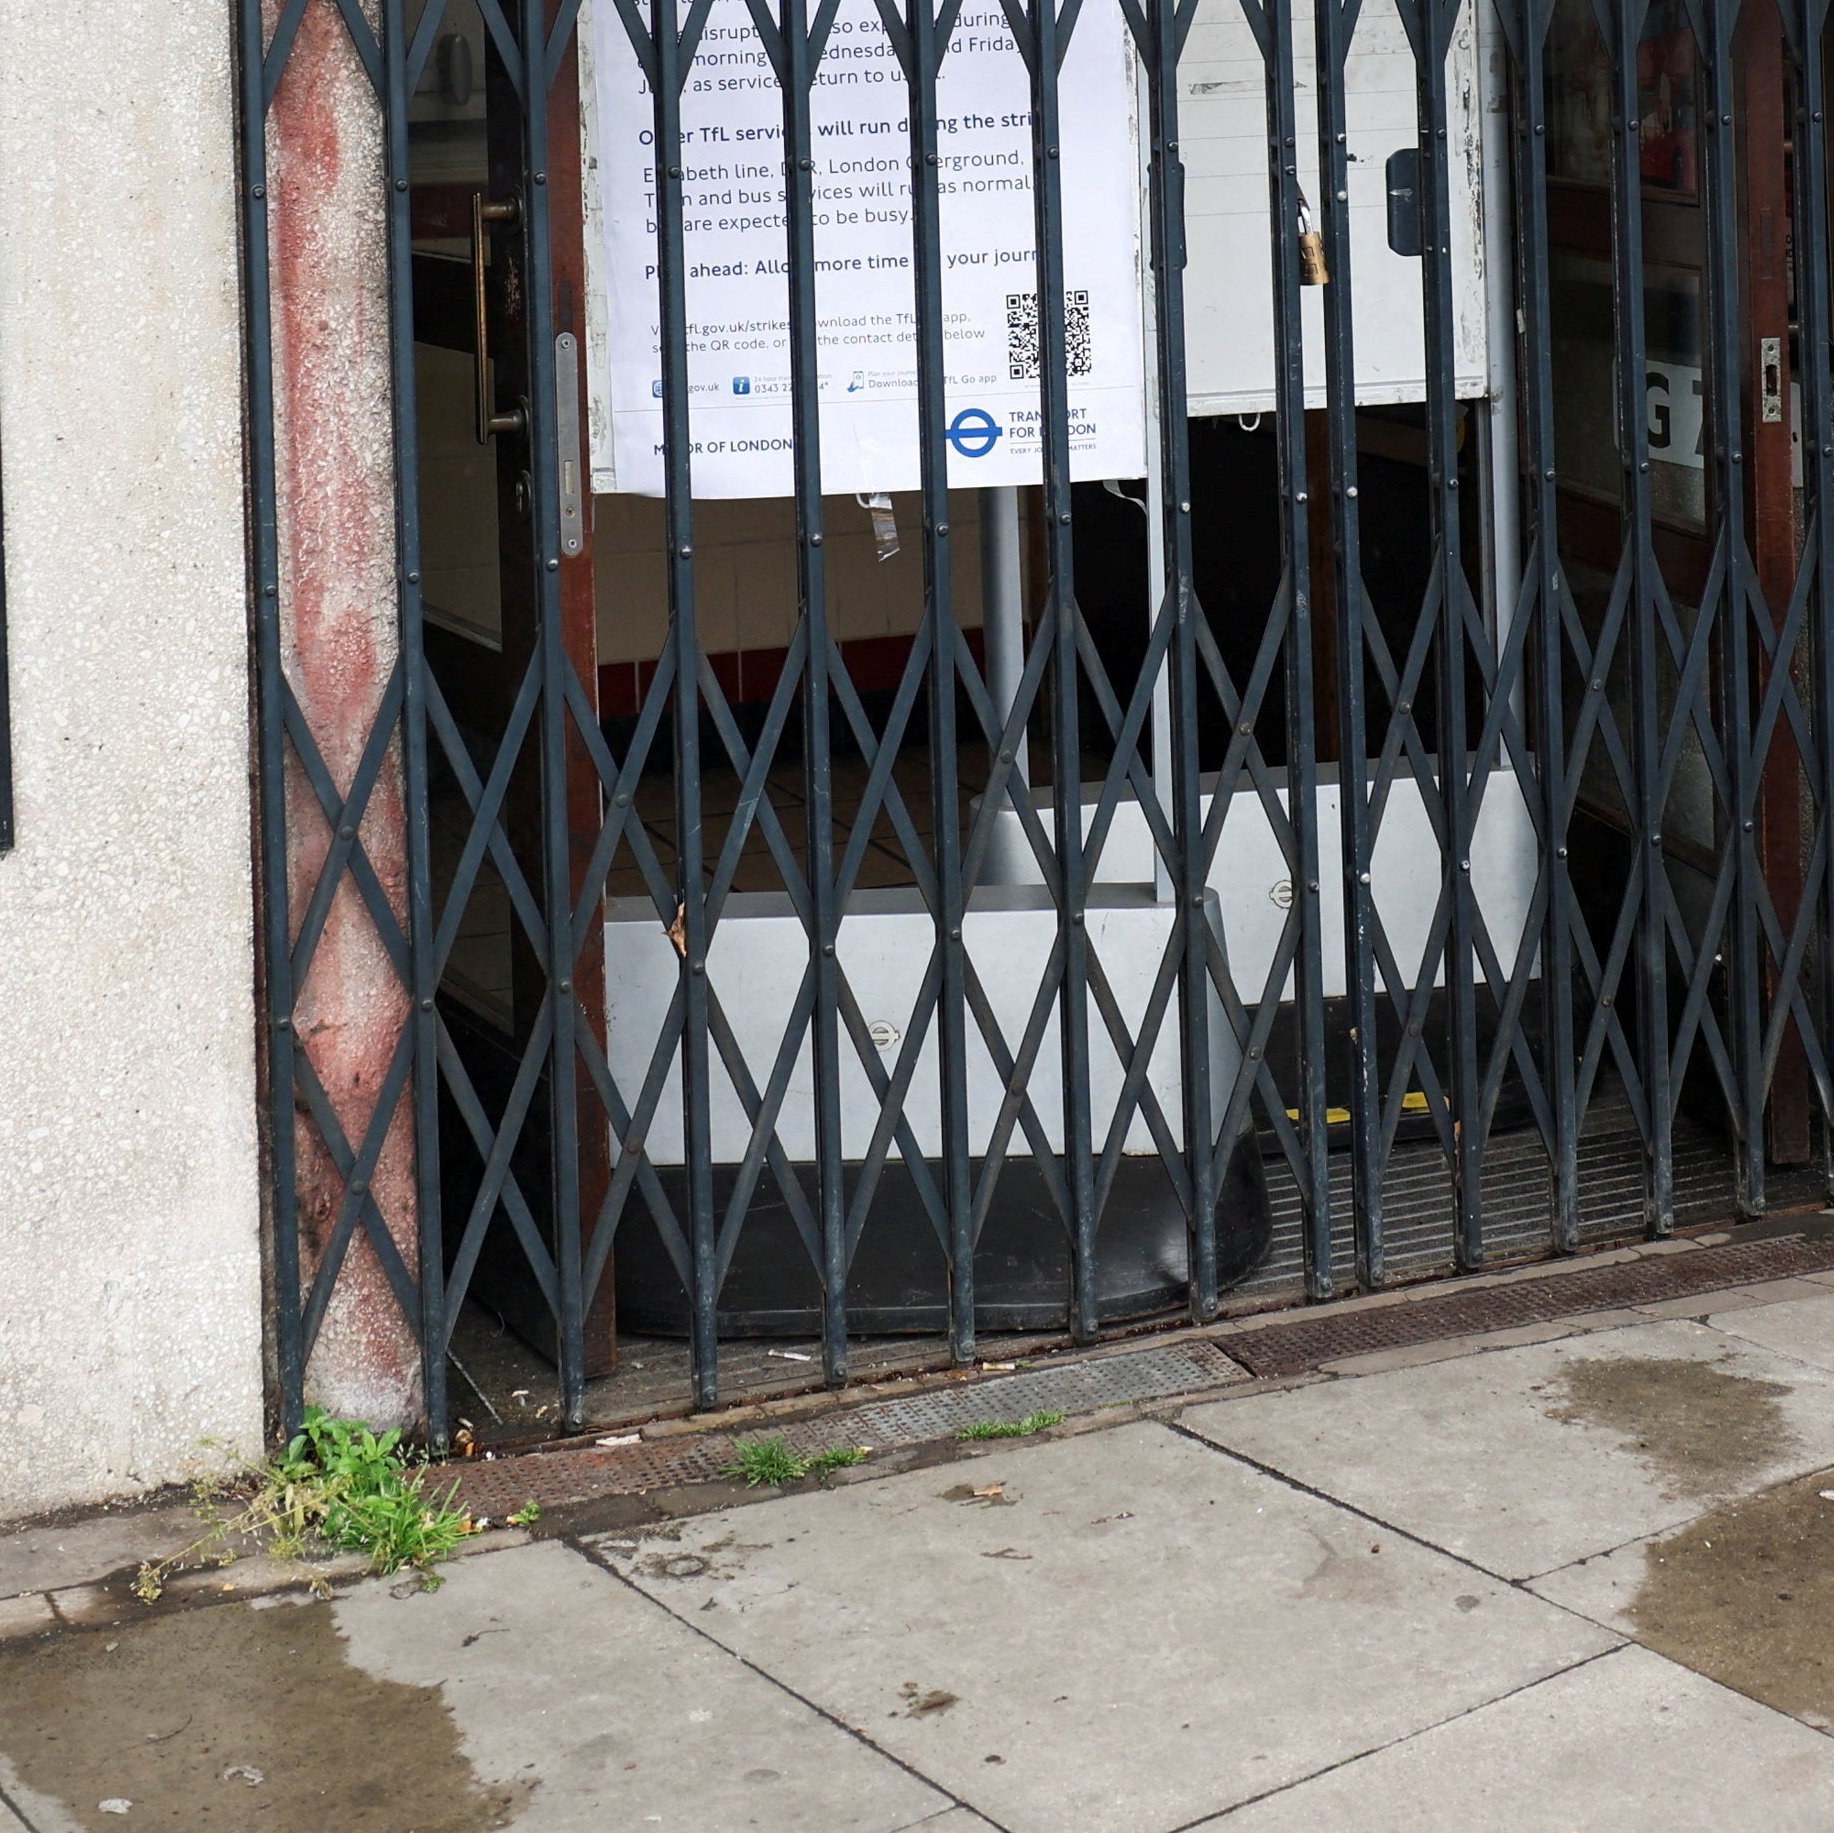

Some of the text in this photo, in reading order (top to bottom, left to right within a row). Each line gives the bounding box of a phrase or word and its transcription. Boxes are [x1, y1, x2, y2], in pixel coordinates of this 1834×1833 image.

[693, 50, 767, 67] morning
[693, 70, 883, 93] as to
[700, 114, 995, 142] TfL will run the
[735, 156, 899, 179] line, London
[699, 190, 732, 206] and
[739, 189, 772, 204] bus
[859, 181, 894, 198] will
[684, 218, 712, 232] are
[836, 209, 858, 225] be
[690, 249, 989, 278] ahead: more time your
[870, 313, 917, 326] the TfL
[710, 340, 730, 351] QR
[773, 338, 787, 349] or
[817, 334, 839, 345] the
[842, 332, 895, 345] contact
[944, 328, 985, 341] below
[943, 375, 997, 385] TfL Go app
[1009, 426, 1036, 439] FOR
[707, 437, 794, 454] OF LONDON
